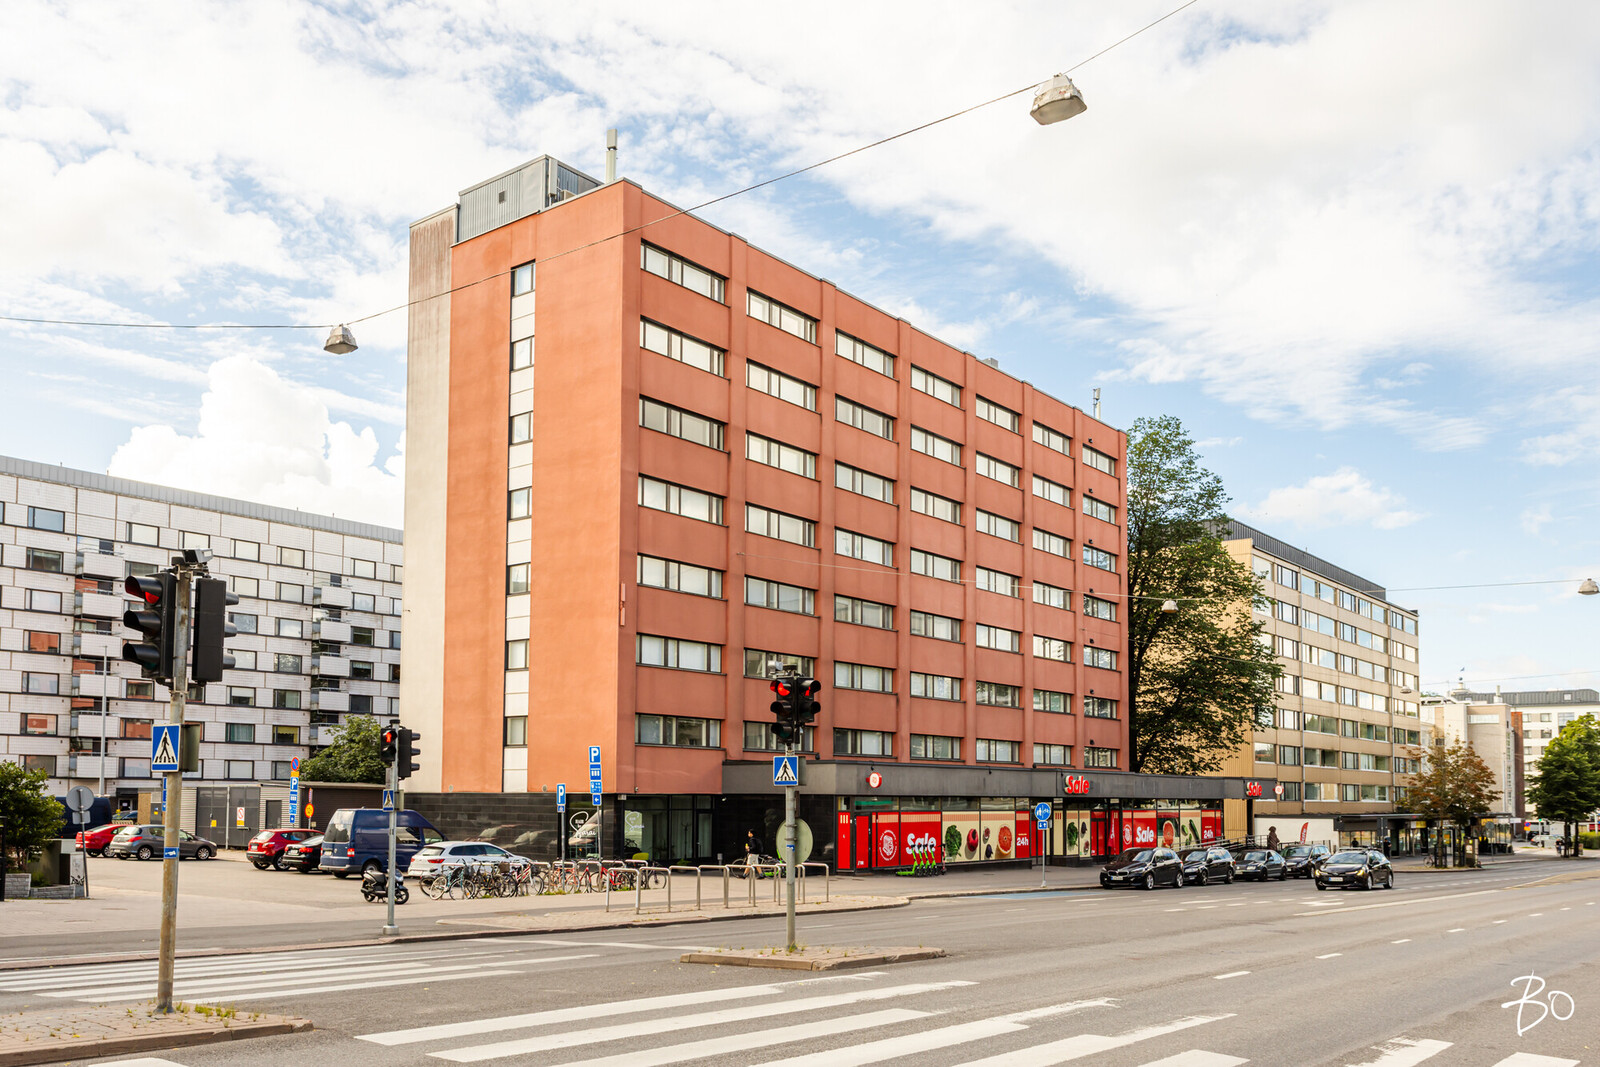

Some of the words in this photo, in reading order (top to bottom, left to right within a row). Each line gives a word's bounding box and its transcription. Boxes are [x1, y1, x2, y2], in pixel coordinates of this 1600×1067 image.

[591, 747, 599, 763] P
[1064, 775, 1090, 794] Sale
[1246, 781, 1263, 797] Sale
[1016, 836, 1029, 846] 24h
[1135, 826, 1154, 843] Sale
[1203, 829, 1214, 839] 24h
[906, 832, 937, 855] Sale
